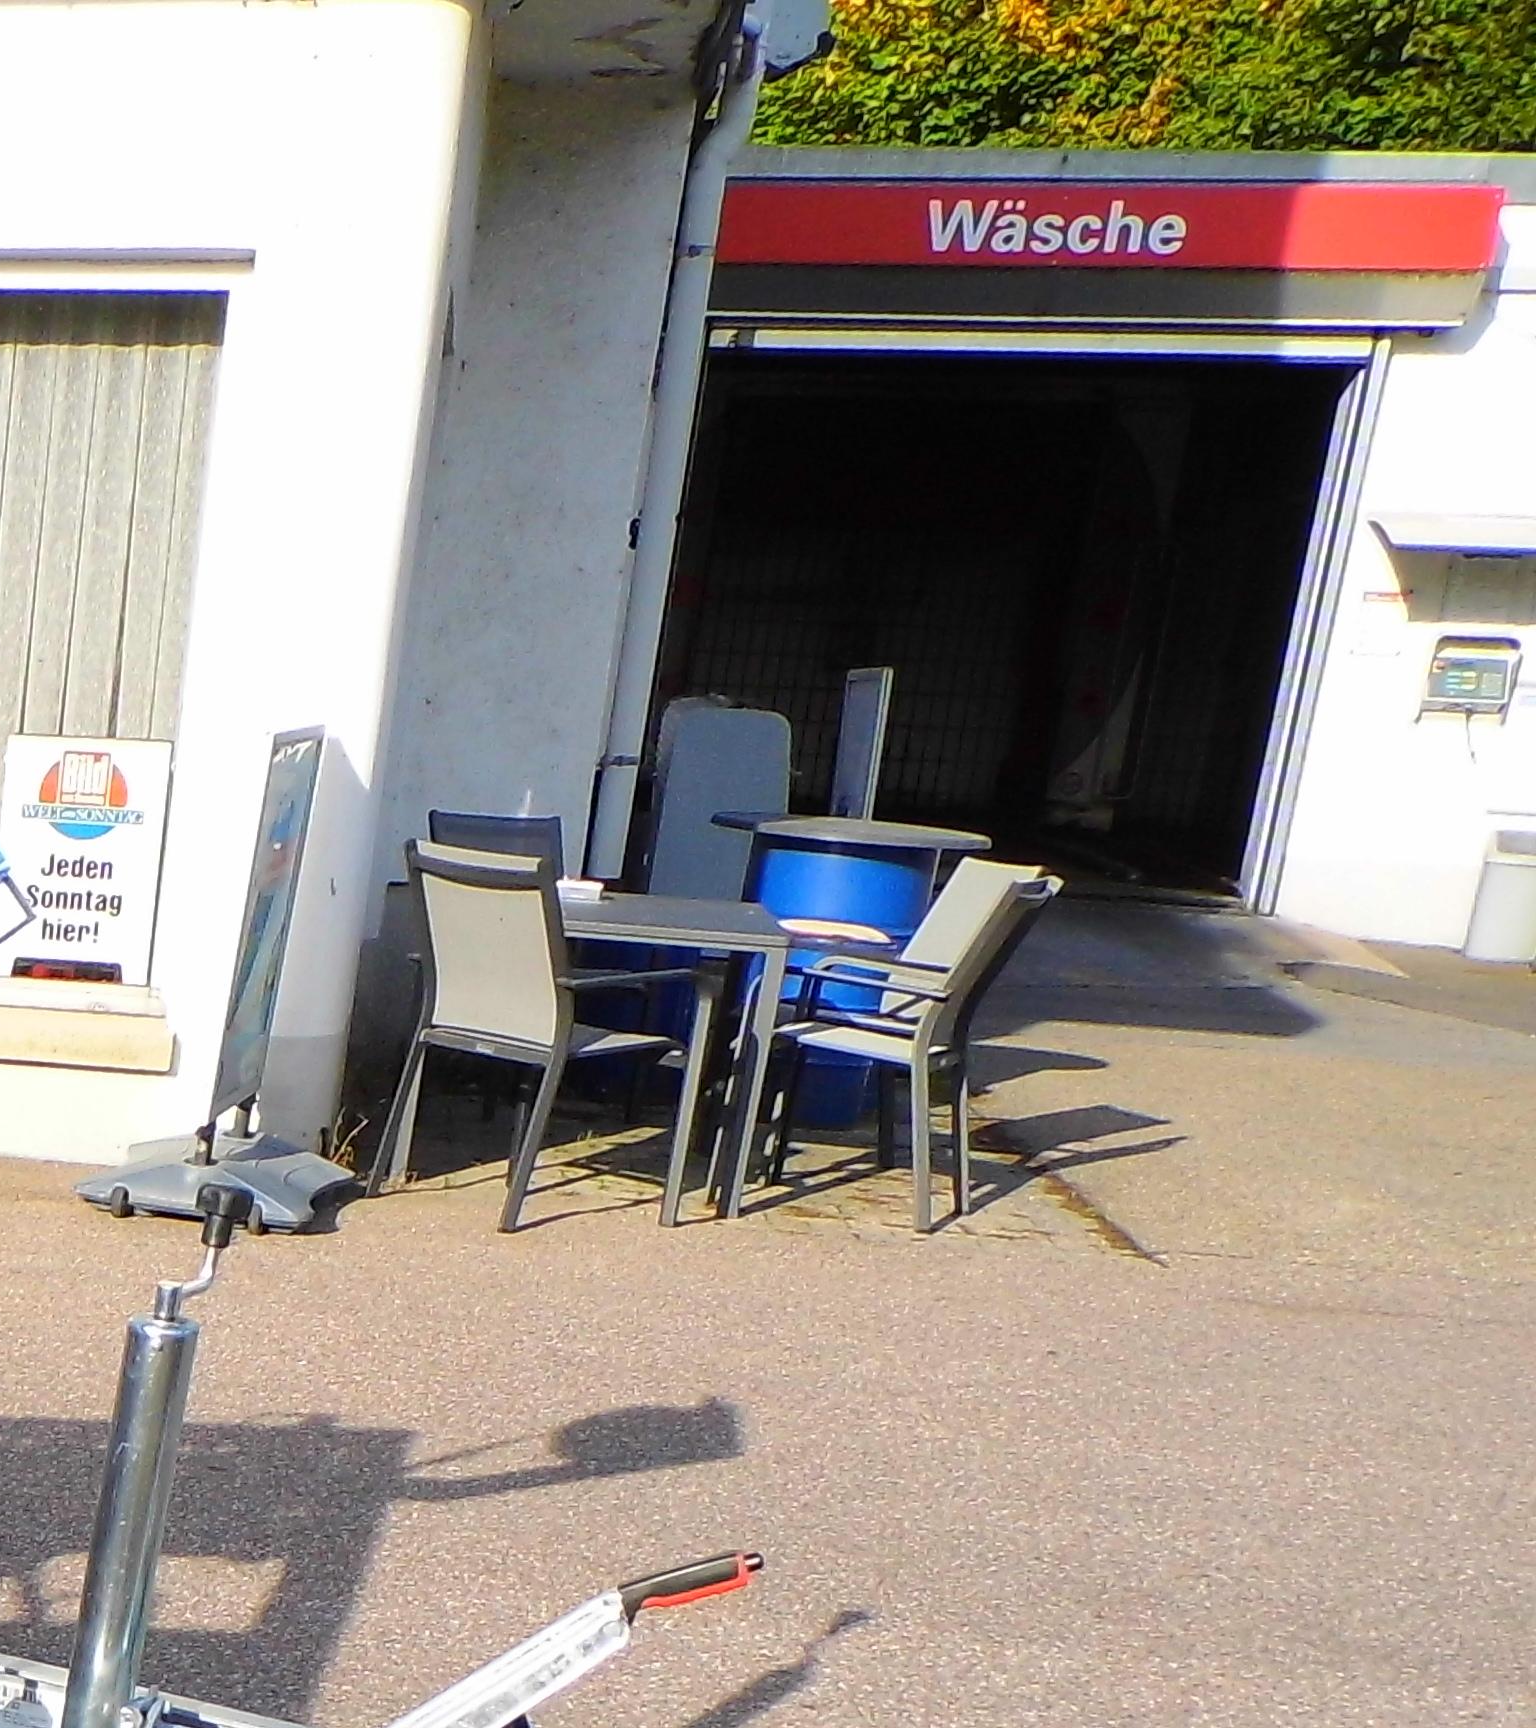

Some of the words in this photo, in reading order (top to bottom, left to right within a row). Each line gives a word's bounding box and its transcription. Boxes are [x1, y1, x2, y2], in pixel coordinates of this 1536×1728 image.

[928, 199, 1187, 256] Wäsche
[75, 807, 144, 825] SONNTAG
[41, 854, 114, 880] Jeden
[26, 884, 123, 917] Sonntag
[41, 919, 99, 943] hier!
